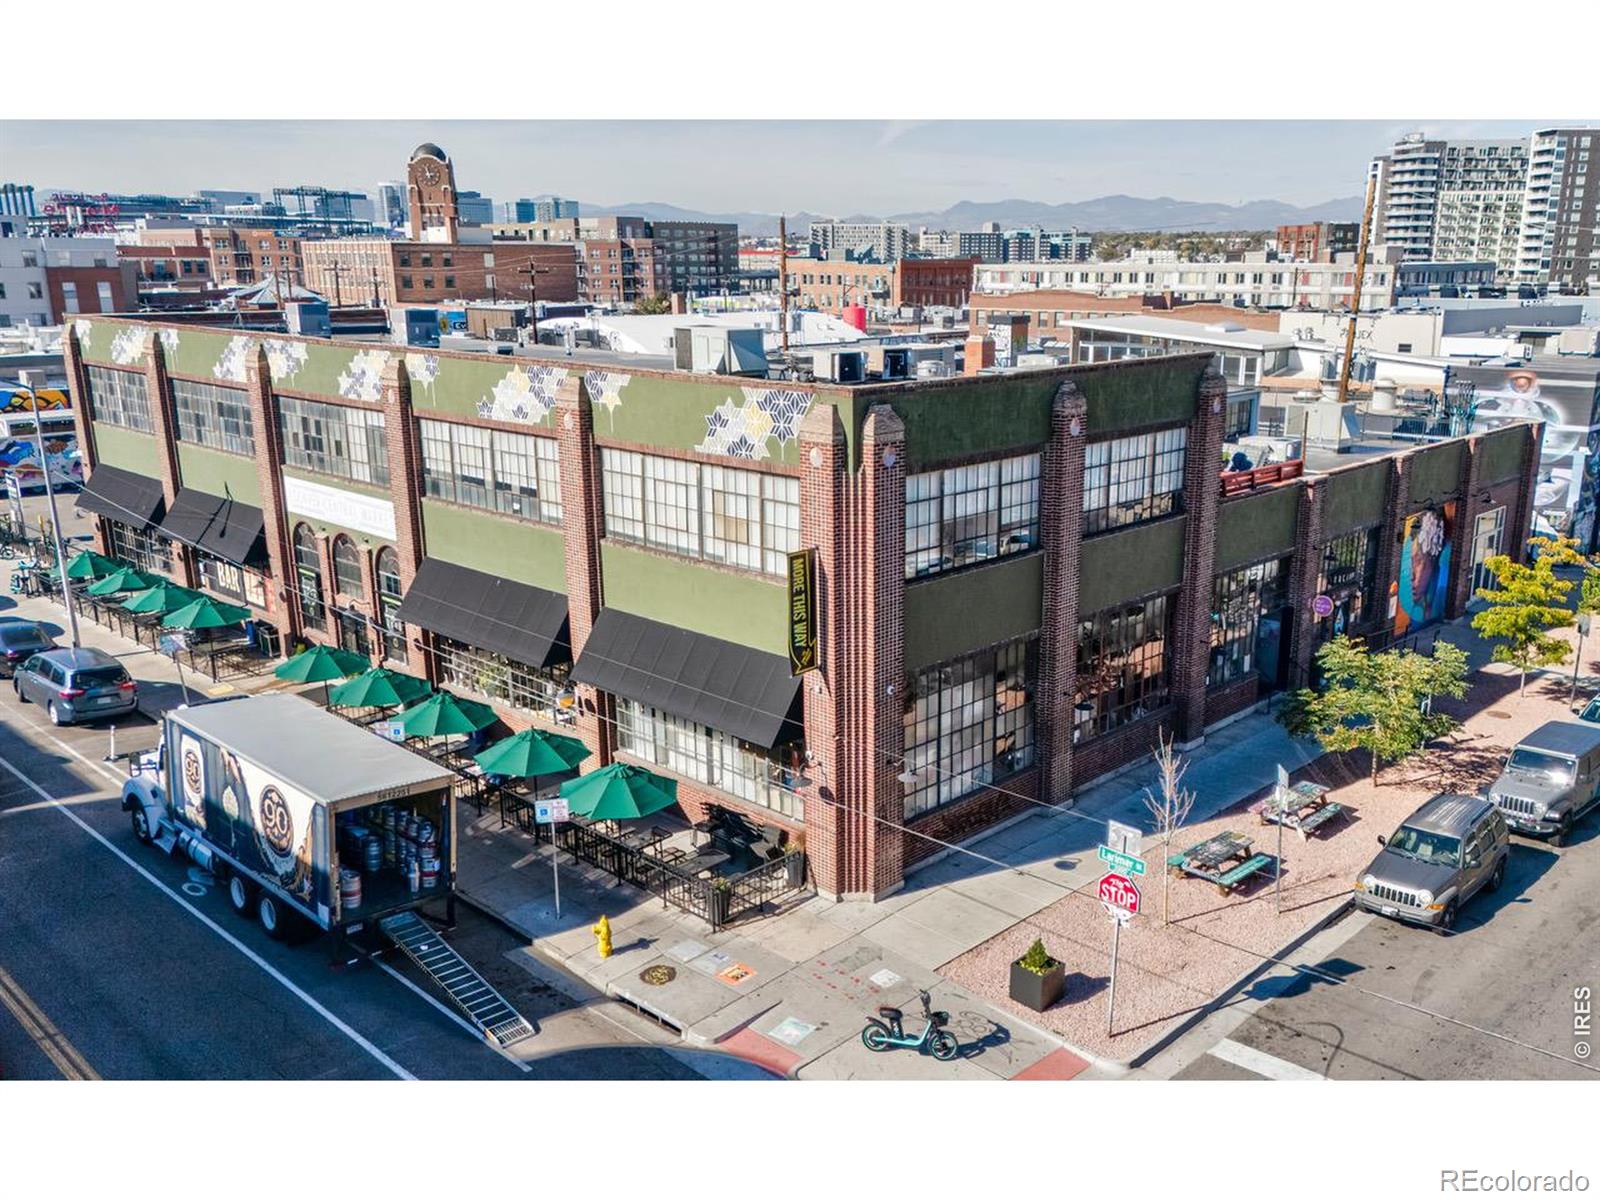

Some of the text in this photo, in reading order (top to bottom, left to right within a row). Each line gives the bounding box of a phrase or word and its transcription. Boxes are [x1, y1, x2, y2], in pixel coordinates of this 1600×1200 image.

[216, 561, 241, 593] BAR
[793, 558, 807, 647] MORE THIS WAY
[264, 798, 288, 835] 90
[1101, 847, 1134, 867] Larimer
[1101, 883, 1136, 909] STOP
